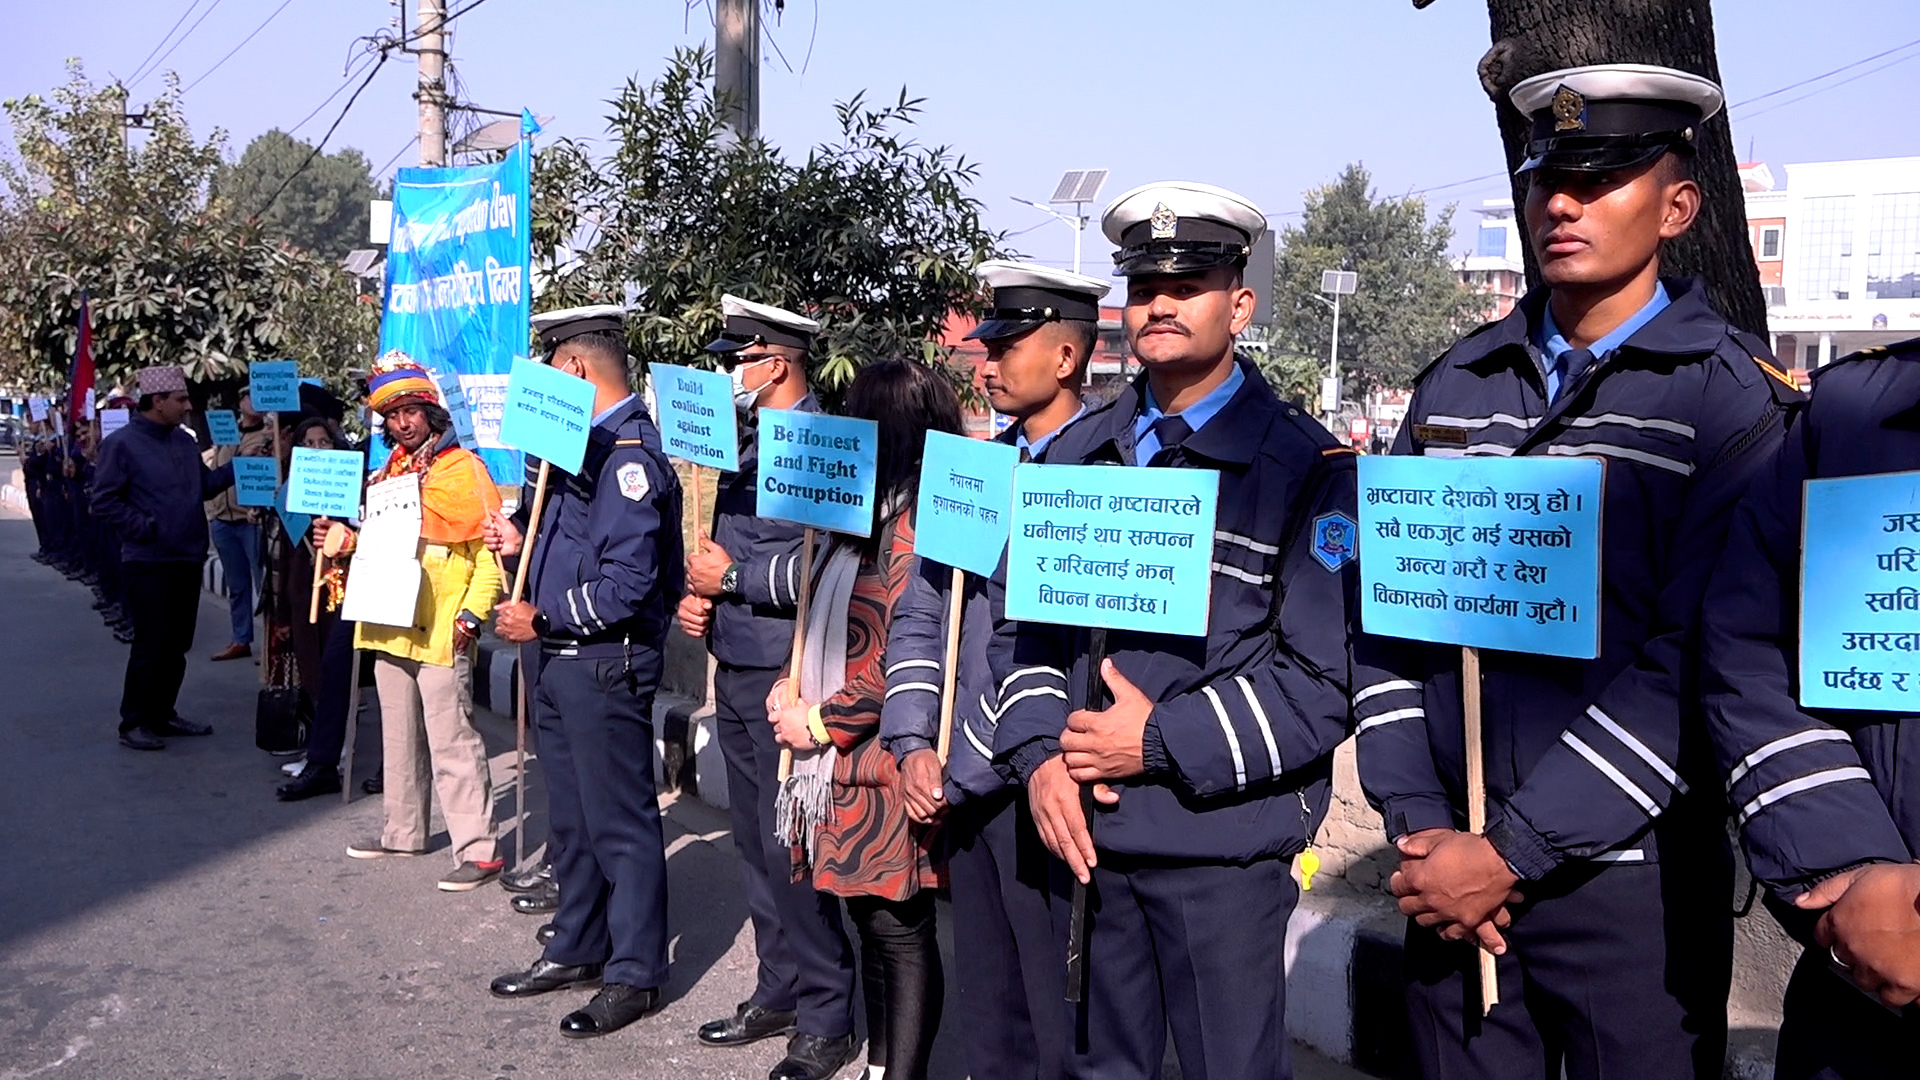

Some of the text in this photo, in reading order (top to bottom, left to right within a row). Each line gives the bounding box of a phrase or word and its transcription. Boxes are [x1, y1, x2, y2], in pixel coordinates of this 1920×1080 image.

[485, 256, 522, 305] दिवस
[677, 378, 703, 396] Build
[672, 400, 715, 417] coalition
[677, 420, 711, 437] against
[774, 425, 861, 452] Be Honest
[670, 438, 724, 459] corruption
[774, 455, 858, 480] and Fight
[950, 468, 984, 493] नेपालमा
[765, 477, 864, 507] Corruption
[1023, 490, 1202, 516] प्रणालीगत भ्रष्टाचारले
[1367, 488, 1436, 506] भ्रष्टाचार
[1443, 486, 1498, 508] देशको
[1505, 492, 1540, 515] शत्रु
[933, 495, 999, 524] सुशासनको पहल
[1024, 521, 1194, 548] धनीलाई थप सम्पन्न
[1376, 517, 1572, 548] सबै एकजुट भई यसको
[1037, 554, 1175, 585] र गरिबलाई झन्
[1396, 557, 1446, 575] अन्त्य
[1494, 564, 1507, 581] र
[1514, 560, 1548, 584] देश
[1039, 584, 1090, 608] विपन्न
[1373, 583, 1448, 610] विकासको
[1454, 594, 1519, 617] कार्यमा
[1824, 666, 1884, 690] पर्दछ
[1892, 673, 1910, 692] र
